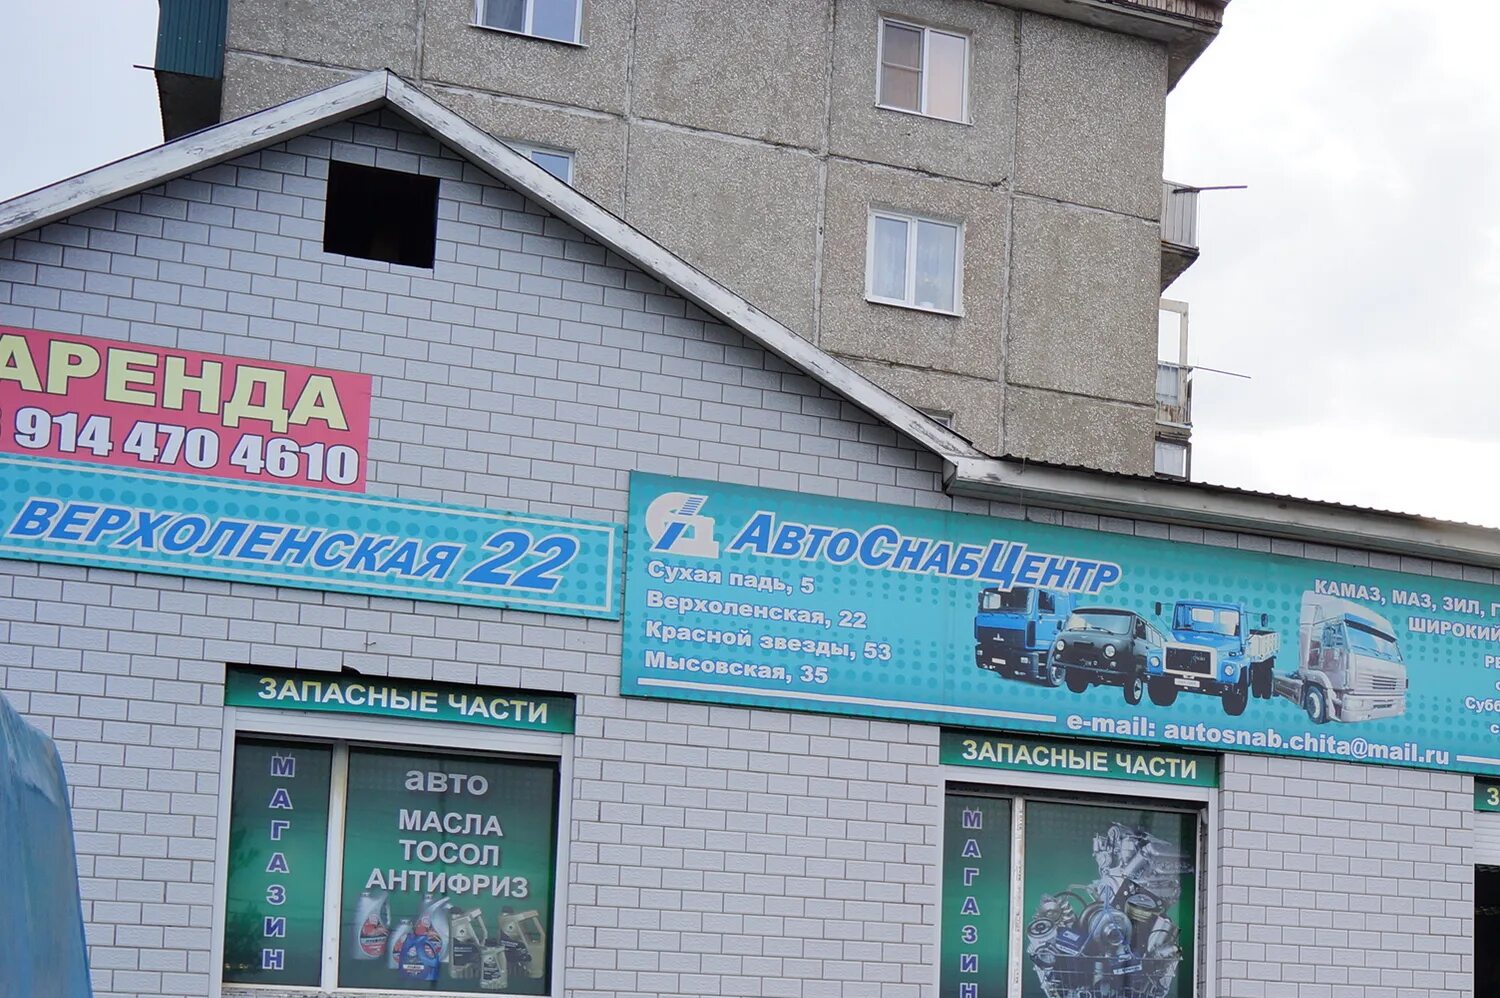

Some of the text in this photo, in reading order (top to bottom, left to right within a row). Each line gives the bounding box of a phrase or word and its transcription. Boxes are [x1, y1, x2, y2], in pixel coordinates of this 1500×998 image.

[0, 333, 348, 432] АРЕНДА
[14, 406, 359, 485] 914 470 4610
[8, 498, 581, 592] ВЕРХОЛЕНСКАЯ 22
[647, 560, 815, 595] Сухая падь, 5
[646, 590, 868, 630] Верхоленская, 22
[1314, 579, 1386, 605] КАМАЗ,
[1392, 590, 1436, 613] МАЗ,
[1442, 596, 1484, 618] ЗИЛ,
[645, 619, 892, 662] Красной звезды, 53
[645, 650, 829, 684] Мысовская, 35
[259, 677, 548, 724] ЗАПАСНЫЕ ЧАСТИ
[1066, 713, 1450, 766] e-mail: autosnab.chita@mail.ru
[1489, 725, 1499, 734] с
[962, 739, 1197, 780] ЗАПАСНЫЕ ЧАСТИ
[405, 770, 488, 796] авто
[398, 809, 503, 837] МАСЛА
[261, 752, 296, 970] МАГАЗИН
[399, 839, 499, 866] ТОСОЛ
[365, 868, 528, 899] АНТИФРИЗ
